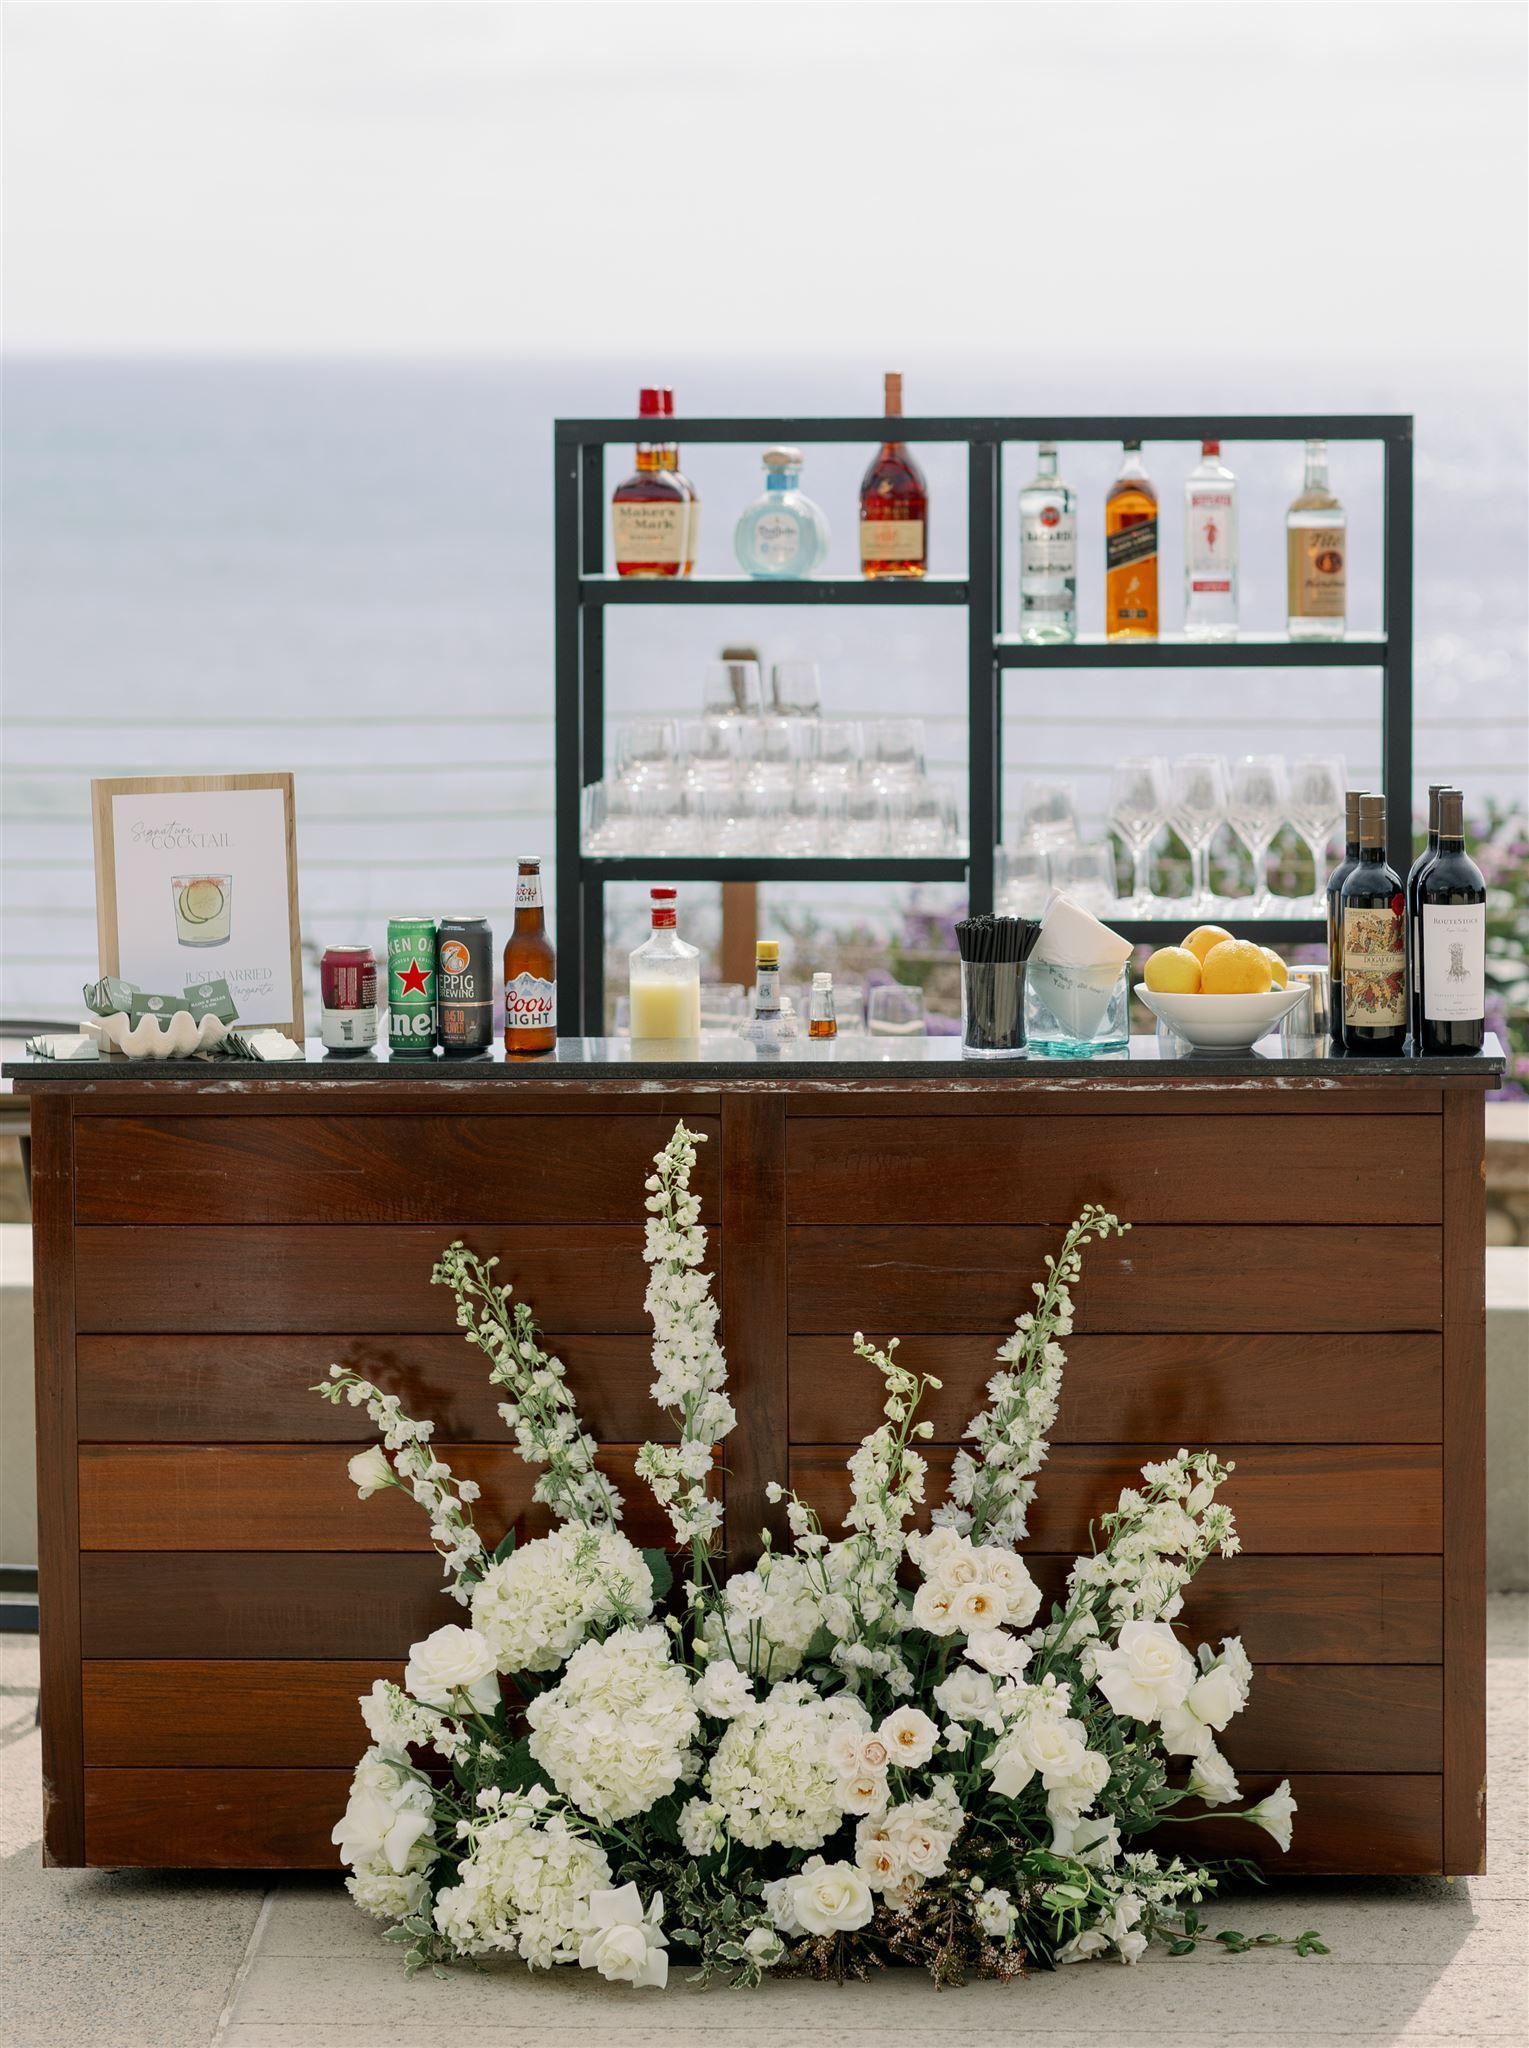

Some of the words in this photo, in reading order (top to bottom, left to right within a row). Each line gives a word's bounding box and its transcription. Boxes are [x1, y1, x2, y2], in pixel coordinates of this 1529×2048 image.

[151, 832, 234, 849] COCKTAIL
[505, 991, 553, 1013] Coors
[508, 1012, 549, 1025] LIGHT
